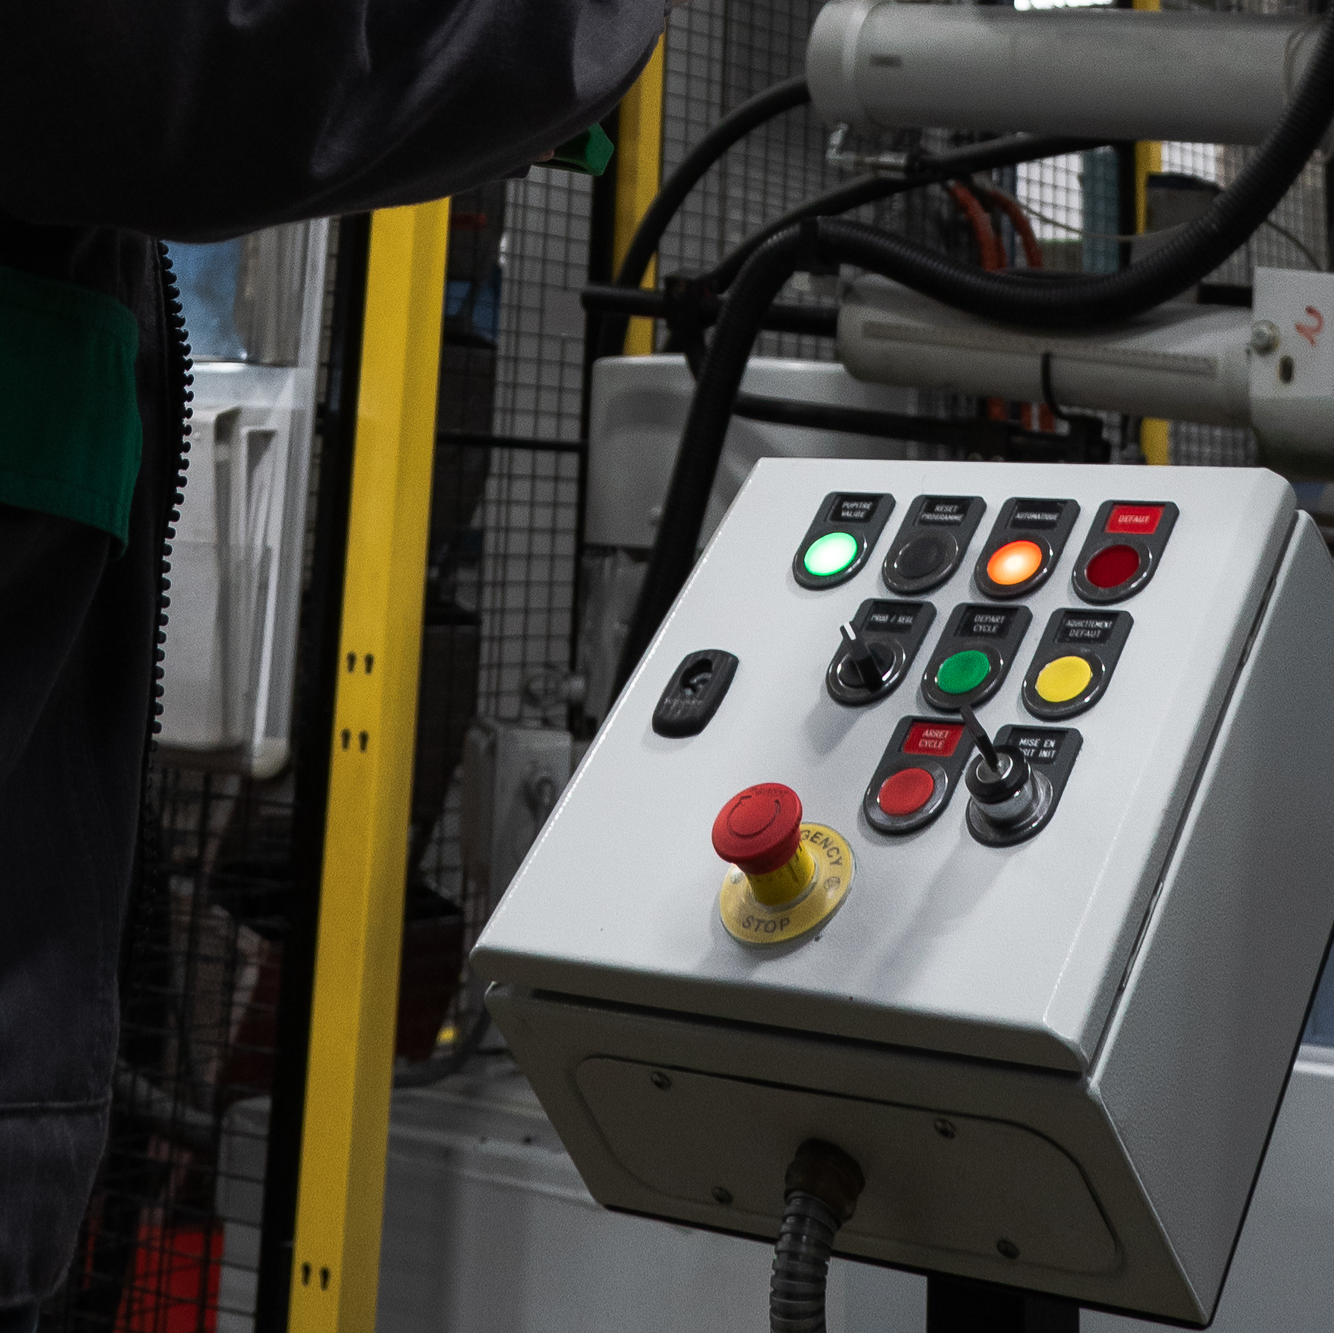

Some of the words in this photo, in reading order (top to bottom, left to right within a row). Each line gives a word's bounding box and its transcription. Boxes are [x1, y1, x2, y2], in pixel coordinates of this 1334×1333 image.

[934, 504, 959, 513] RESET
[920, 512, 965, 522] PROGRAMME
[1117, 514, 1151, 524] DEFAUT
[973, 614, 1006, 624] DEPART
[972, 623, 998, 634] CYCLE
[1068, 628, 1102, 639] DEFAUT
[922, 728, 951, 740] ARRET
[917, 739, 945, 750] CYCLE
[1018, 737, 1041, 748] MISE
[1043, 738, 1056, 748] EN
[1038, 748, 1056, 759] INIT
[801, 829, 843, 867] GENCY
[742, 914, 791, 934] STOP
